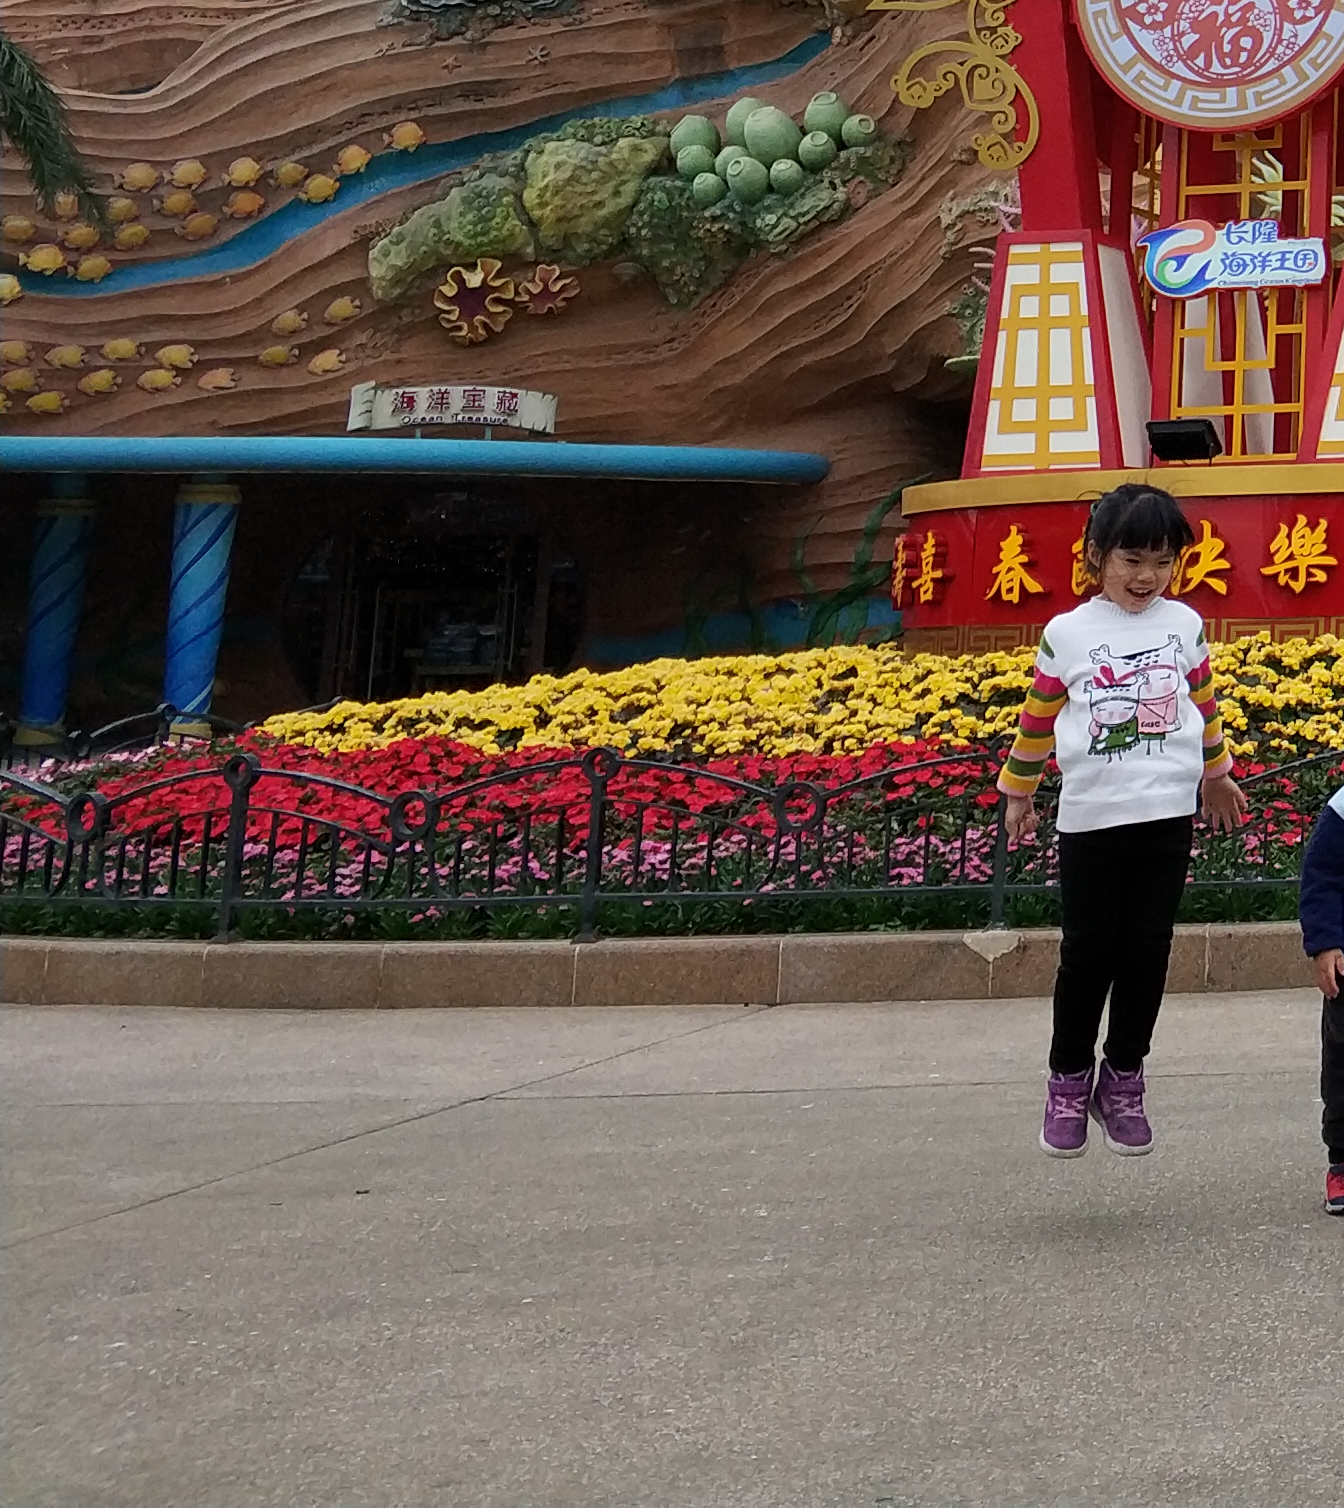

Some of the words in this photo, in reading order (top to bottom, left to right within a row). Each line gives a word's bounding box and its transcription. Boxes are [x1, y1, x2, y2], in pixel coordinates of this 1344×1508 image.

[1222, 221, 1278, 245] 长隆
[1219, 249, 1320, 277] 海洋王国
[391, 387, 519, 414] 海洋宝藏
[401, 415, 443, 424] Ocean
[452, 413, 510, 424] Treasure
